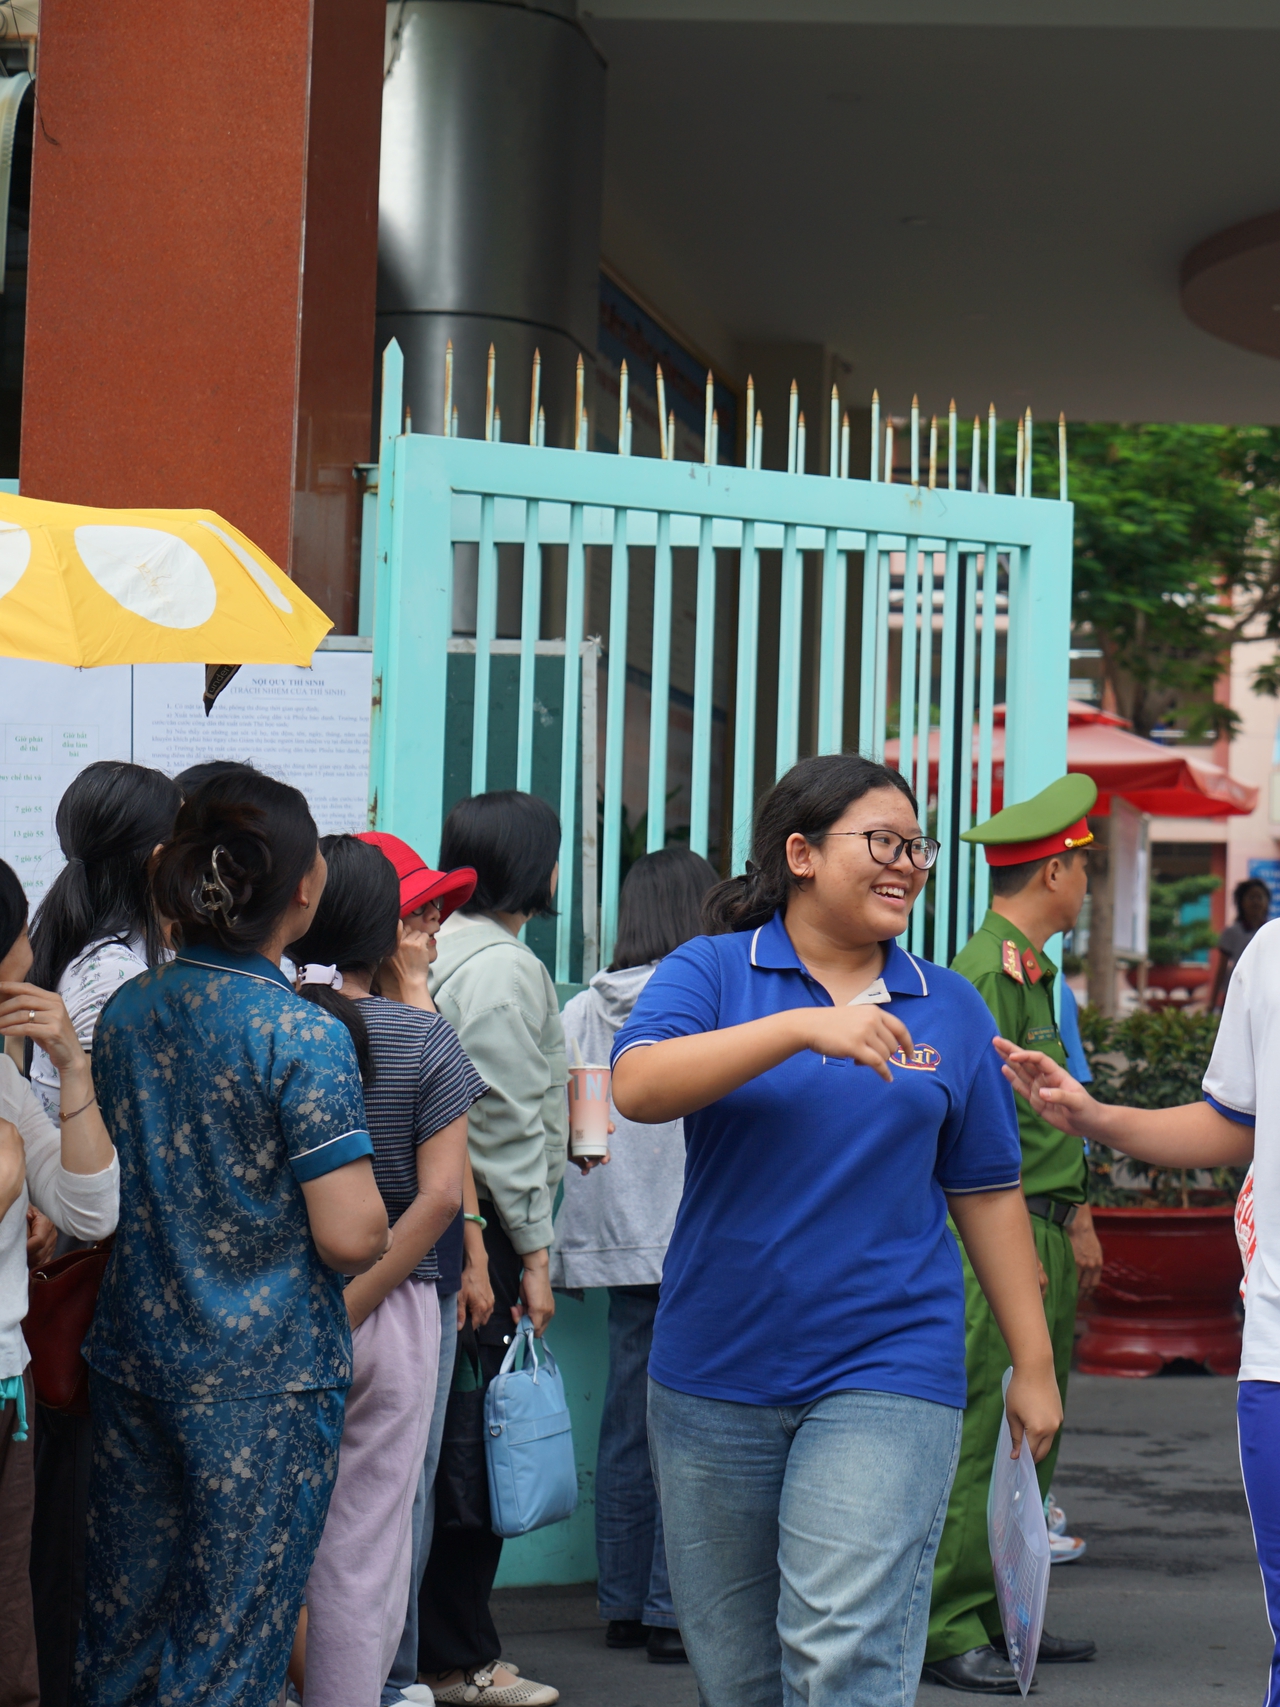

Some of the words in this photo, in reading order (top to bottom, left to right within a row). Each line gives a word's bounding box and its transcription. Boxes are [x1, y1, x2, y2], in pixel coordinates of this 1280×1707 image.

[209, 666, 230, 692] under
[252, 678, 266, 686] NỘI
[289, 678, 303, 686] THÍ
[230, 686, 260, 695] (TRÁCH
[262, 687, 289, 695] NHIỆM
[325, 688, 346, 696] SINH)
